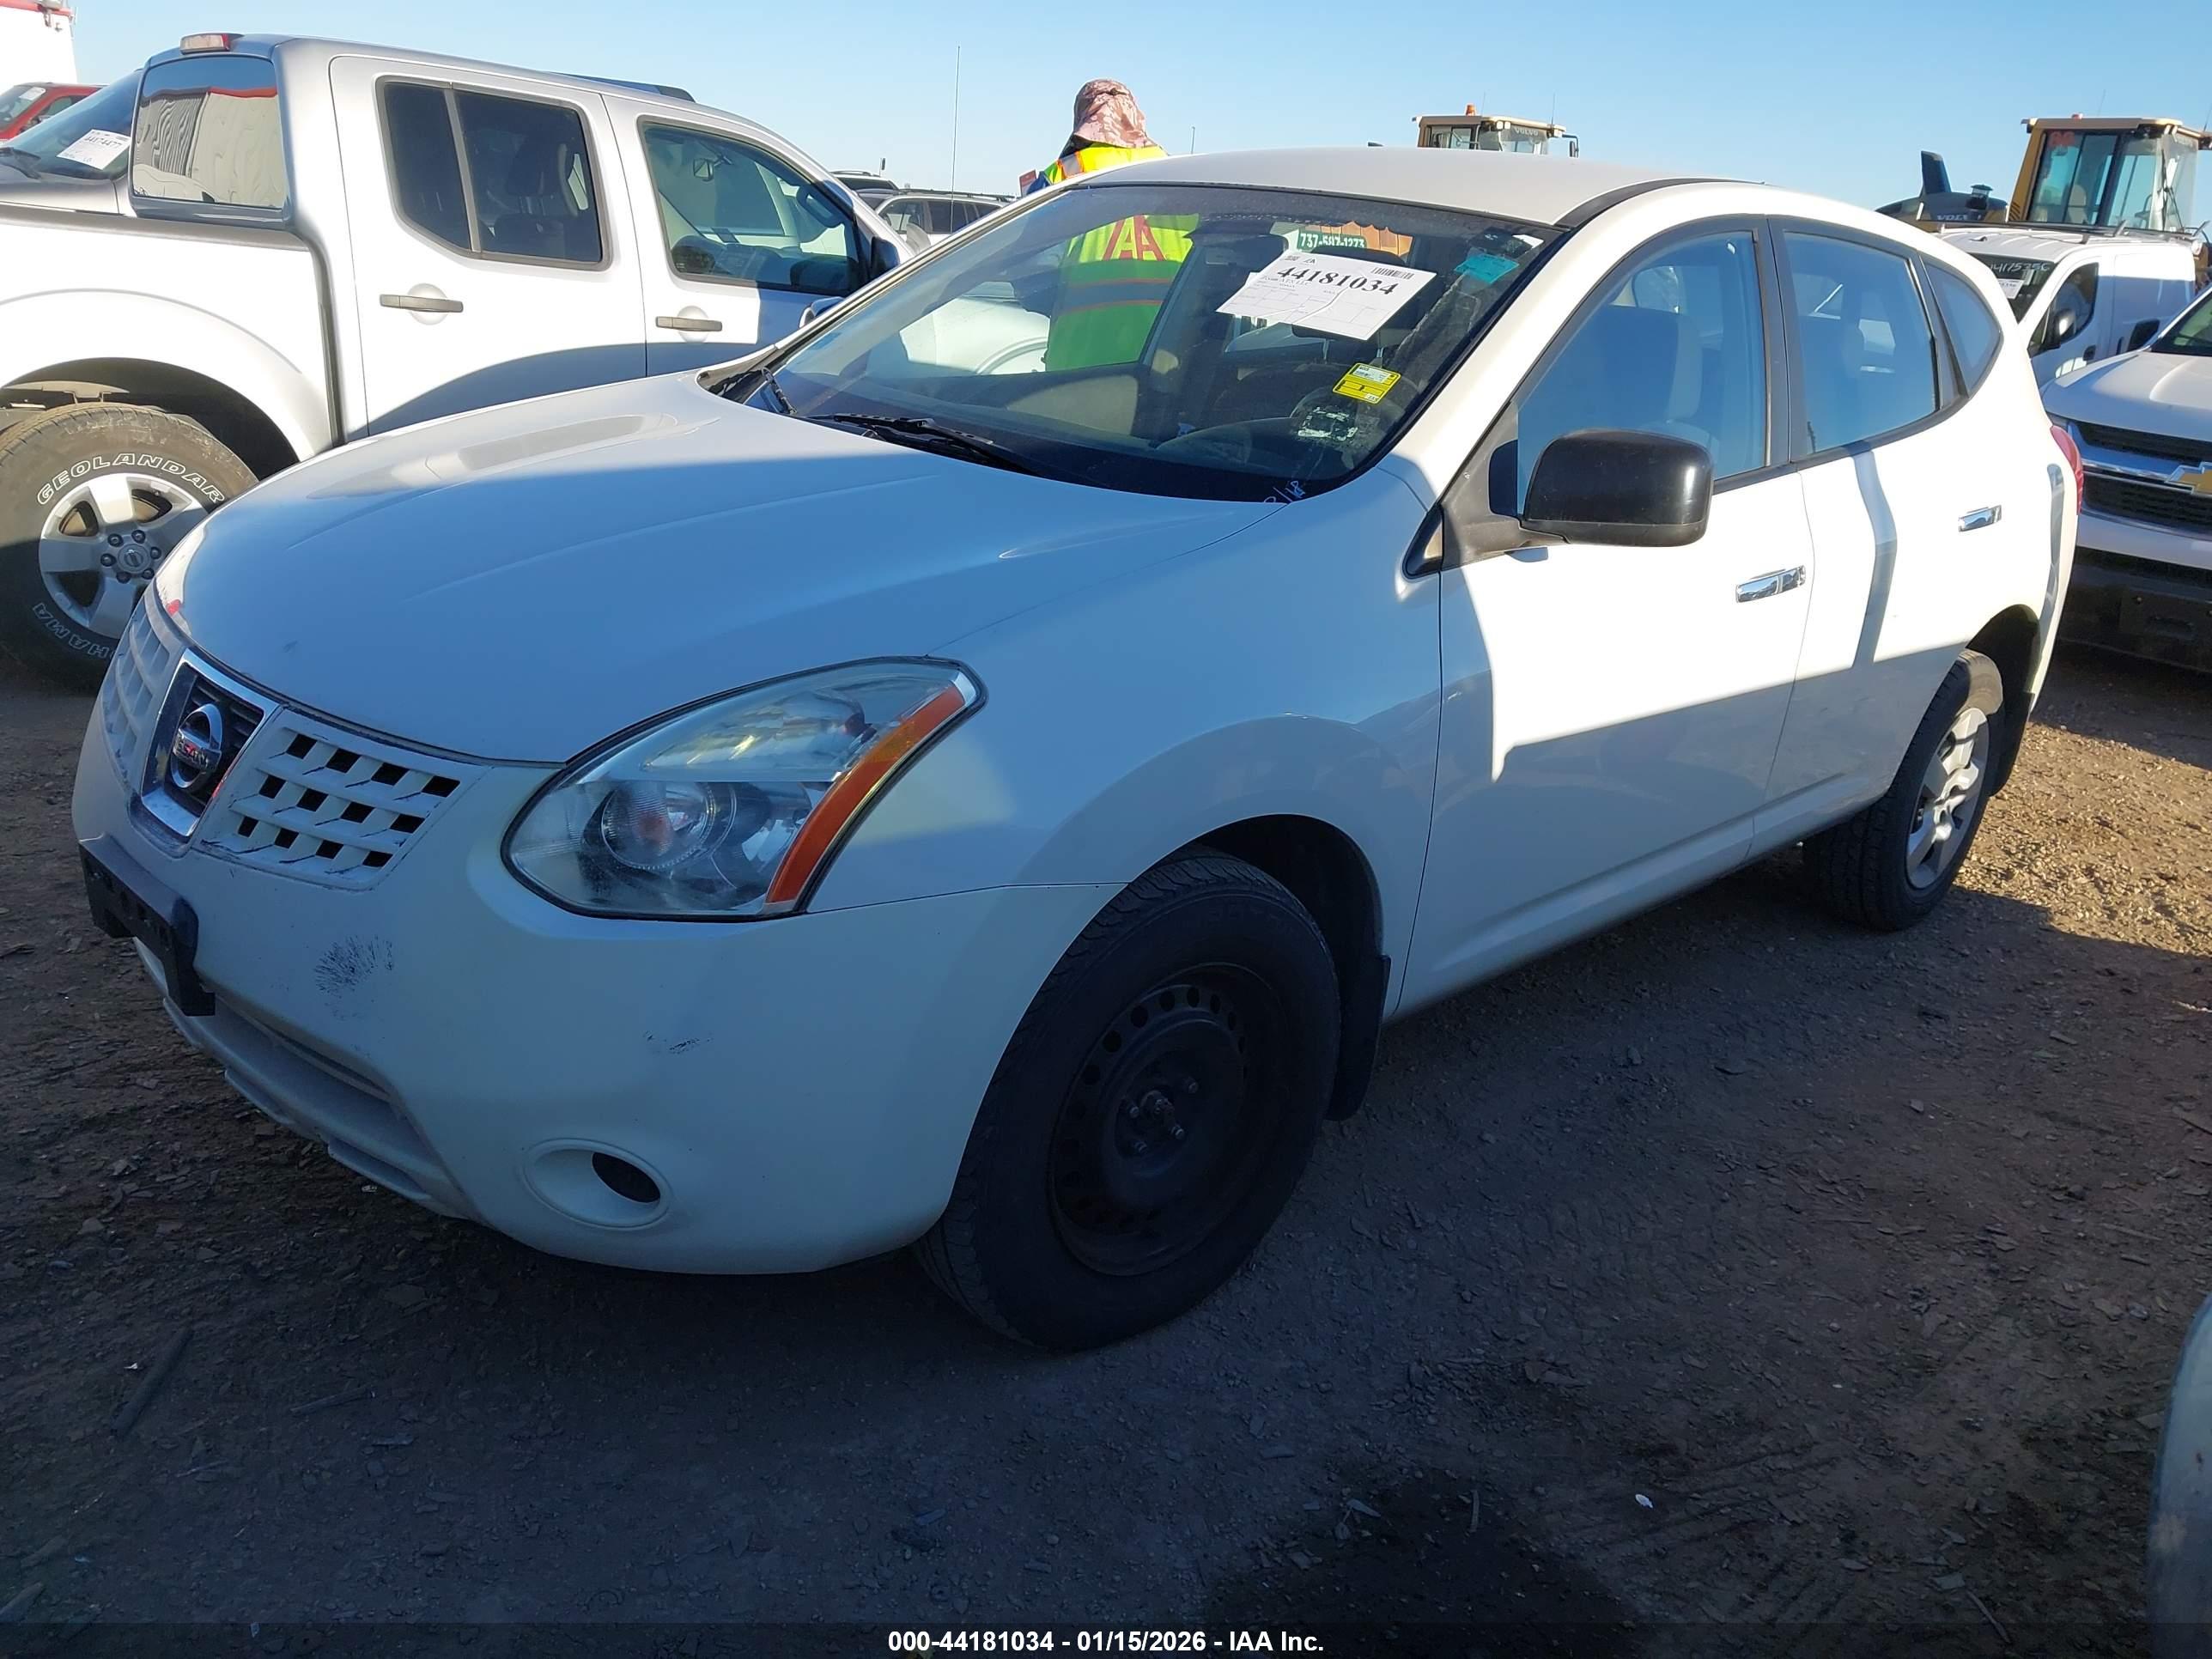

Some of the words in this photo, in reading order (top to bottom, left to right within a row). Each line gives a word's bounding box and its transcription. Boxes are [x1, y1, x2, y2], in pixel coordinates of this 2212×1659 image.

[1514, 126, 1539, 136] VOLVO
[1278, 267, 1398, 295] 44181034
[37, 453, 225, 505] GEOLANDAR
[33, 602, 115, 659] HAMA
